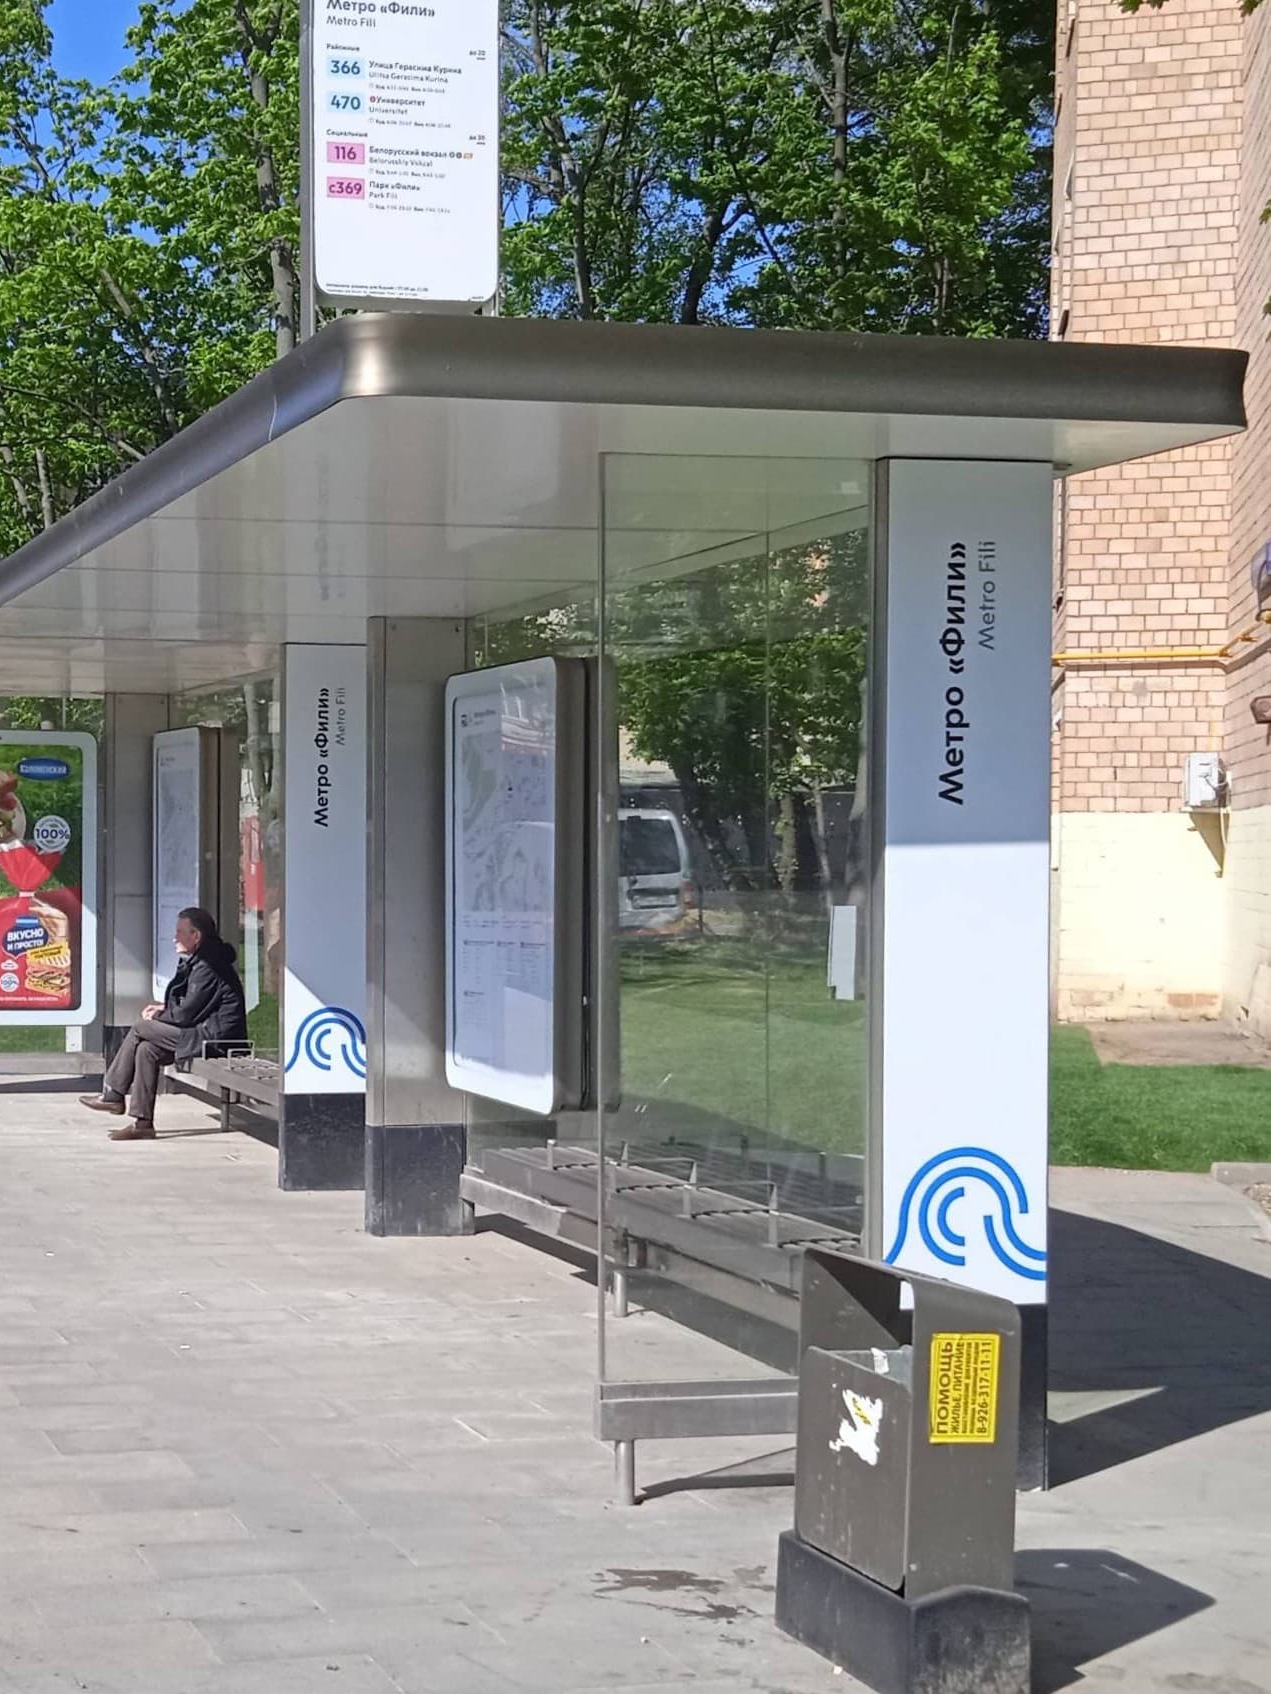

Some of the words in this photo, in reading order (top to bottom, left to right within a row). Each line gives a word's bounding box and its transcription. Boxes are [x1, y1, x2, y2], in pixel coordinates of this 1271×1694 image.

[326, 0, 376, 14] Метро
[380, 2, 435, 18] «Фили»
[326, 15, 357, 26] Metro
[330, 60, 361, 75] 366
[368, 61, 393, 70] Улица
[330, 95, 361, 110] 470
[334, 145, 357, 161] 116
[368, 146, 420, 157] Белорусский
[328, 181, 363, 196] с369
[368, 181, 390, 191] Парк
[978, 541, 996, 573] Fili
[938, 541, 966, 675] «Фили»
[978, 580, 996, 650] Metro
[314, 688, 330, 758] «Фили»
[335, 708, 346, 746] Metro
[938, 686, 970, 805] Метро
[314, 764, 332, 828] Метро
[35, 828, 70, 839] 100%
[7, 928, 44, 941] ВКУСНО
[954, 1342, 965, 1394] ПИТАНИЕ
[937, 1341, 955, 1434] ПОМОЩЬ
[976, 1341, 992, 1434] 8-926-317-11-11
